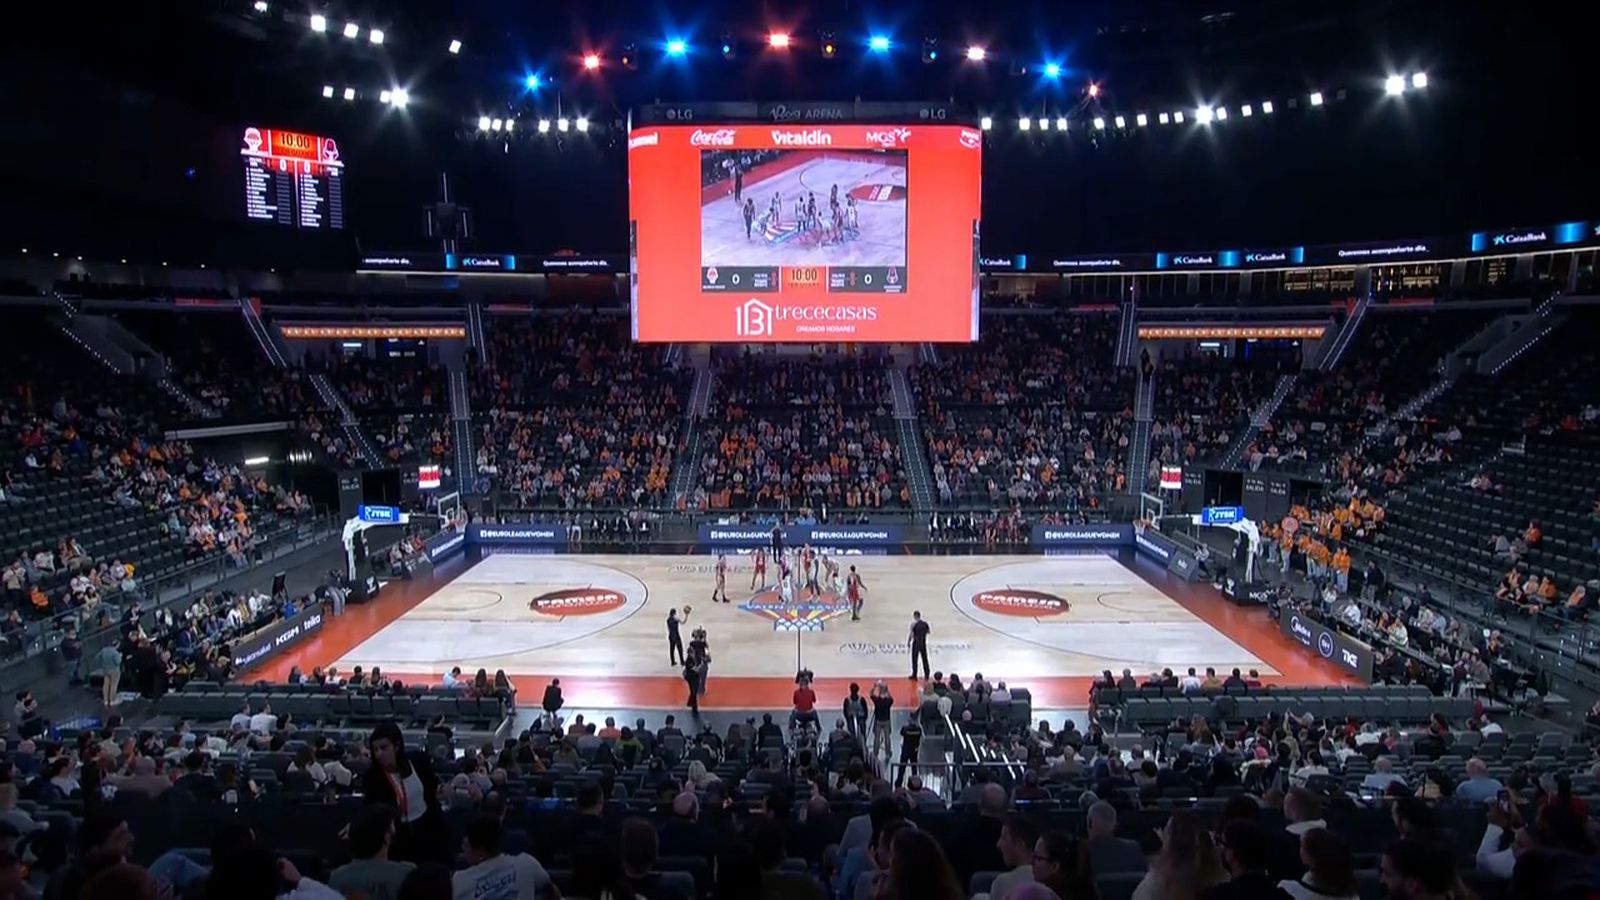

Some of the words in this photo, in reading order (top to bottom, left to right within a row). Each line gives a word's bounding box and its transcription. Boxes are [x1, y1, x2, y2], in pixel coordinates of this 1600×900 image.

[677, 109, 693, 120] LG
[805, 108, 844, 120] ARENA
[930, 109, 946, 120] LG
[280, 132, 310, 149] 10:00
[866, 131, 896, 143] MGS
[1505, 231, 1547, 244] CaixaBank
[731, 273, 740, 286] 0
[791, 268, 818, 281] 10:00
[864, 273, 873, 286] 0
[775, 303, 878, 322] trececasas
[370, 508, 391, 518] JYSK
[1214, 511, 1235, 519] JYSK
